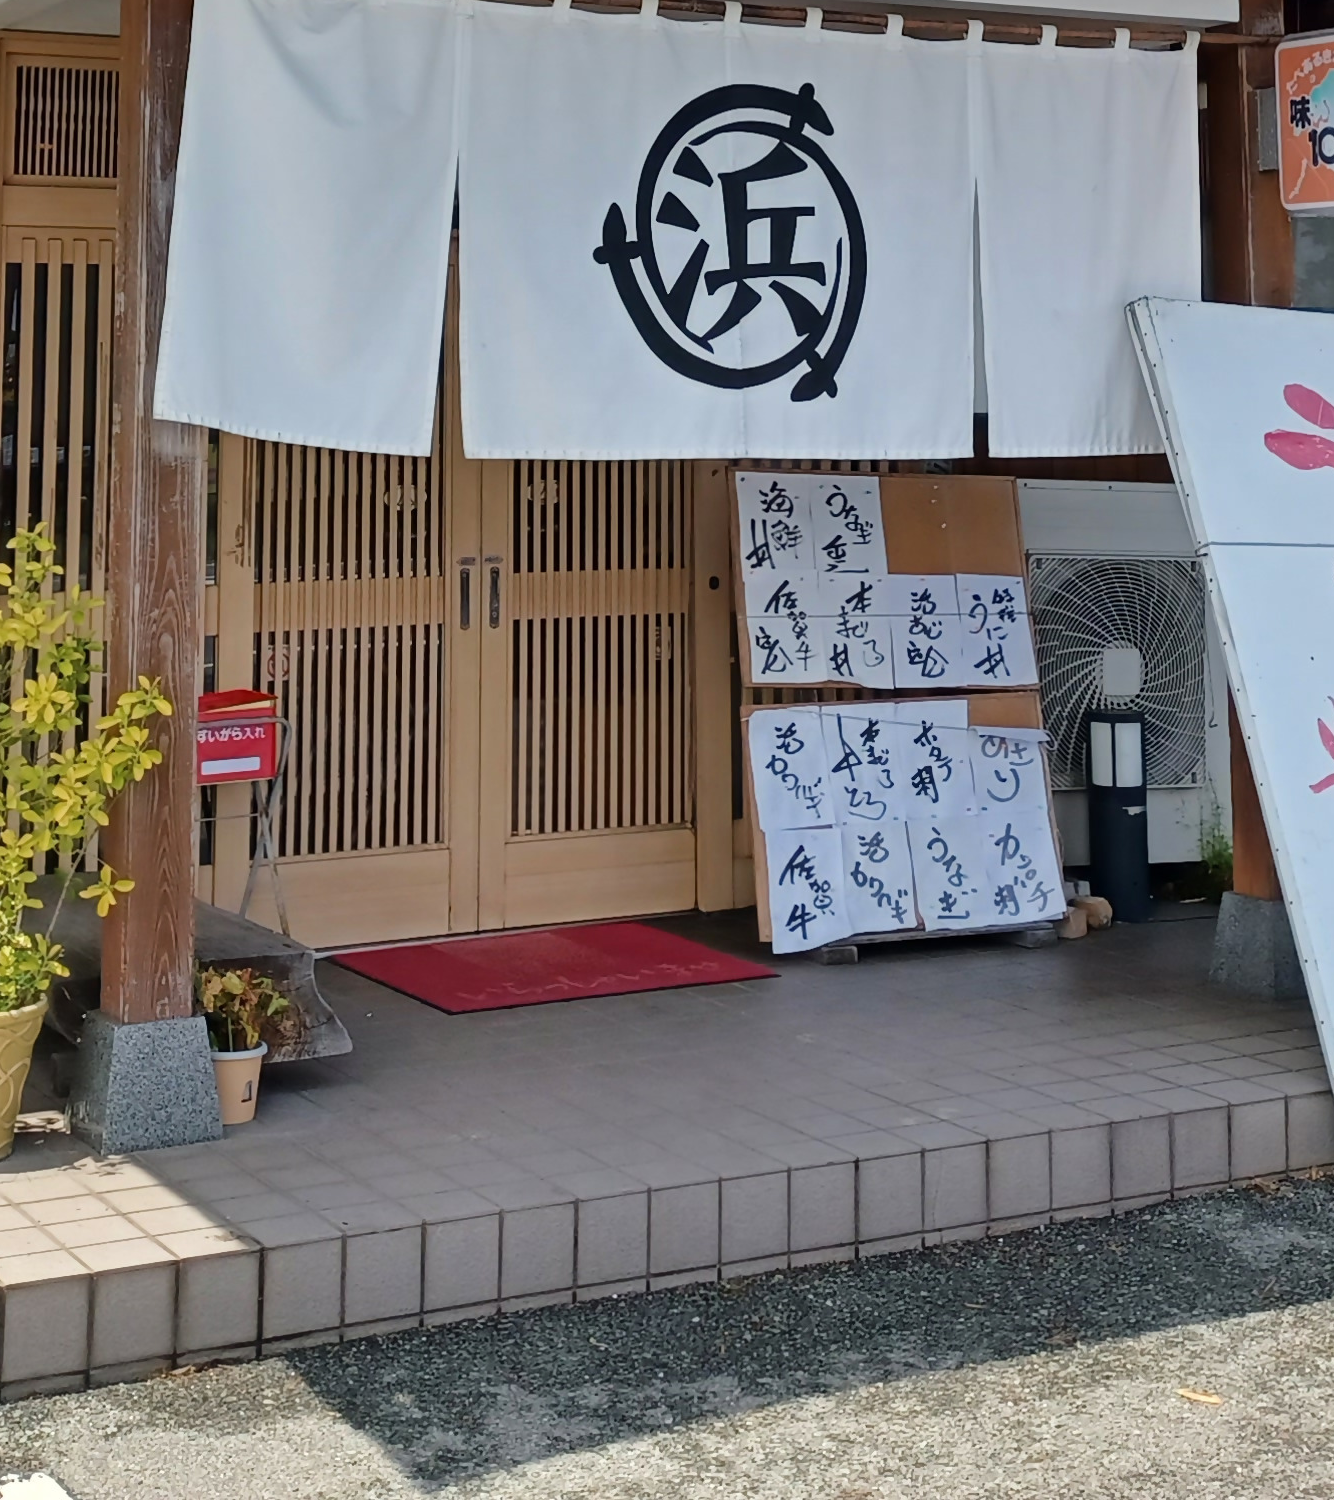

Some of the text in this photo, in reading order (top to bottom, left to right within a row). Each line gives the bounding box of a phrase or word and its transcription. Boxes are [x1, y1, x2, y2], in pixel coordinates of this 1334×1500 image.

[1290, 96, 1312, 130] 味
[197, 726, 266, 744] すいがら入れ
